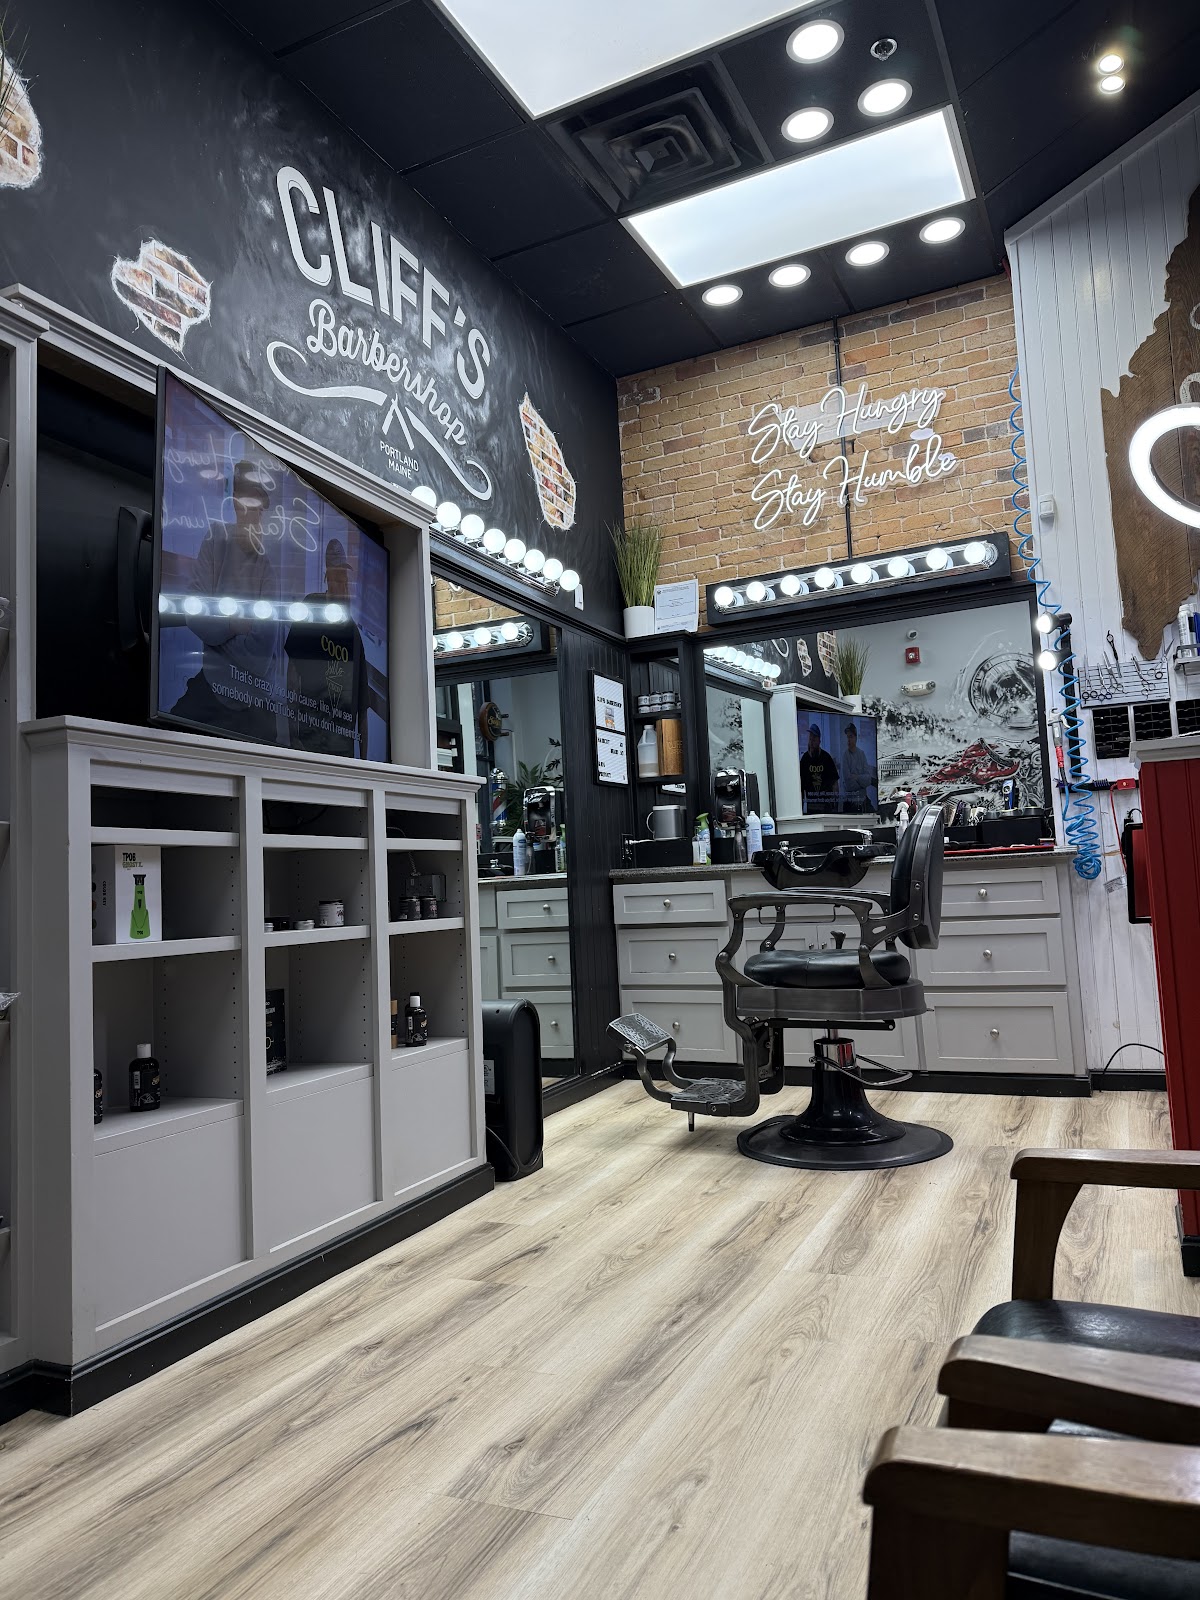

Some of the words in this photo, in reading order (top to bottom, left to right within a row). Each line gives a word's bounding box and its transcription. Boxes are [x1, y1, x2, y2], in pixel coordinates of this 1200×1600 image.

[276, 166, 491, 400] CLIFF'S
[306, 298, 467, 446] Barbershop
[748, 403, 824, 464] Stay
[820, 384, 944, 436] Hungry
[379, 440, 420, 472] PORTLAND
[388, 458, 413, 480] MAINE
[751, 469, 827, 530] Stay
[823, 434, 958, 505] Humble
[321, 635, 349, 663] COCO
[211, 682, 253, 708] somebody
[254, 697, 264, 709] on
[265, 697, 297, 722] YouTube,
[297, 709, 308, 723] but
[308, 715, 320, 728] you
[320, 718, 335, 733] don't
[229, 664, 253, 685] That's
[254, 677, 274, 696] crazy
[299, 694, 318, 711] cause,
[342, 711, 353, 722] see
